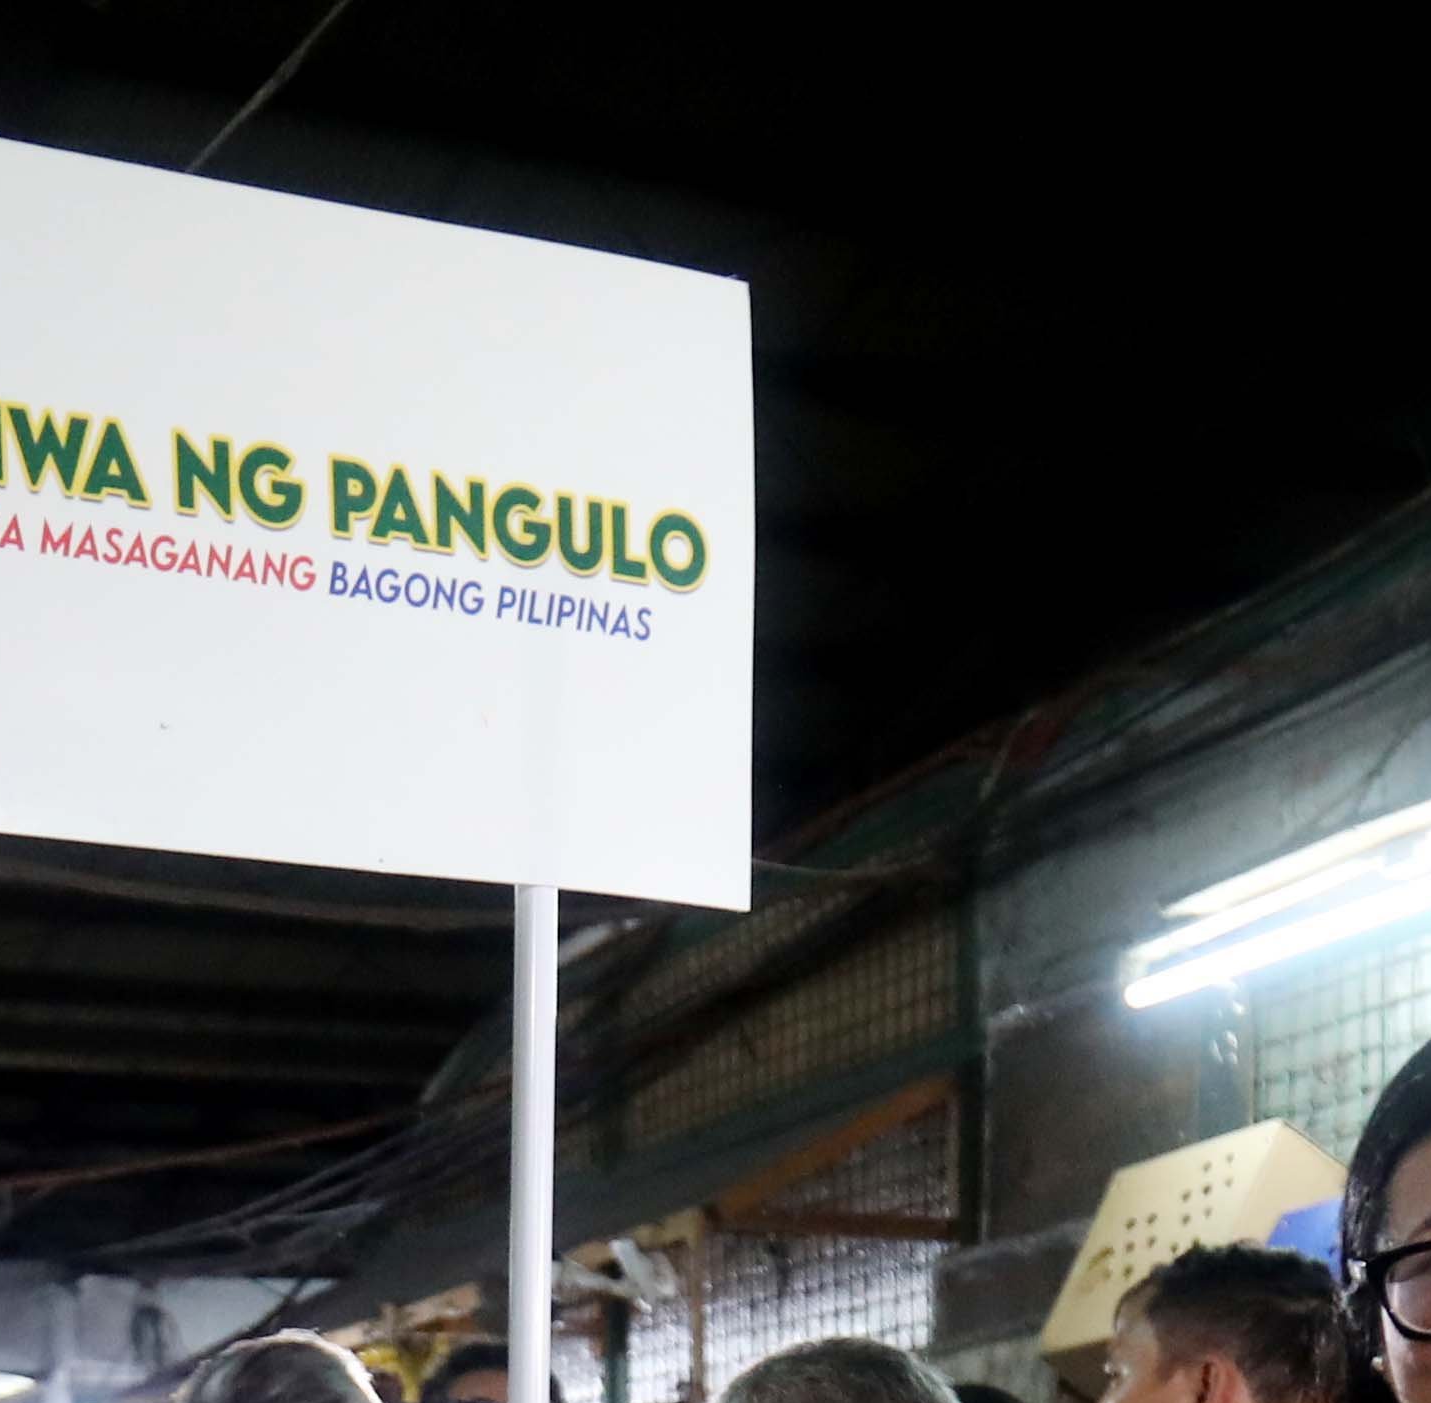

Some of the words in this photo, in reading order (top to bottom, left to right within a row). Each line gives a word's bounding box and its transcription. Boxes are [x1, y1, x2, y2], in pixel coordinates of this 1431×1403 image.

[39, 520, 318, 593] MASAGANANG
[327, 560, 485, 619] BAGONG
[494, 584, 653, 644] PILIPINAS
[172, 428, 305, 528] NG
[329, 456, 709, 595] PANGULO
